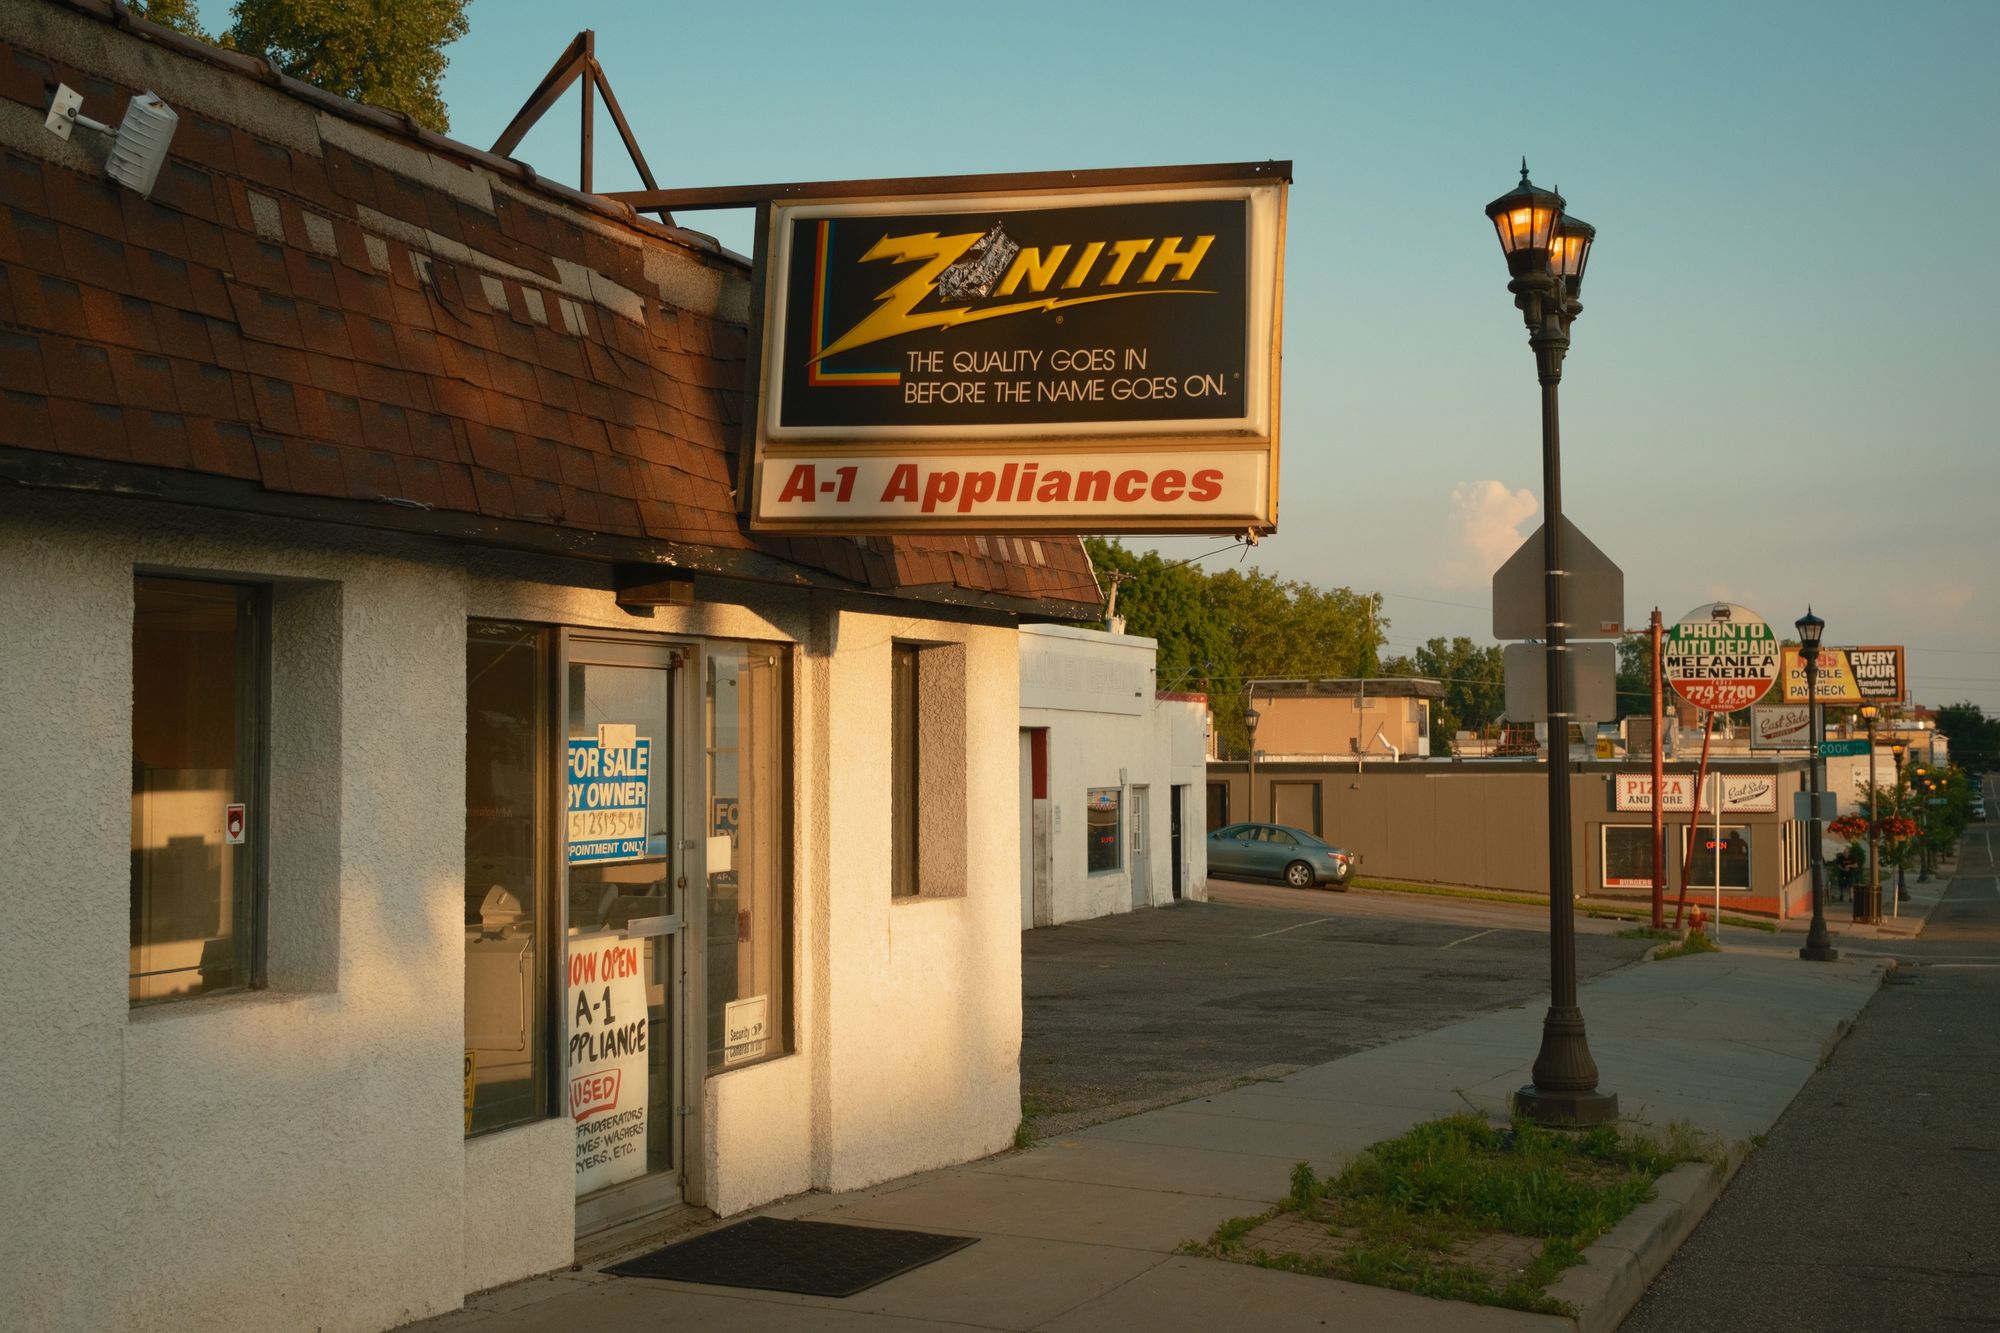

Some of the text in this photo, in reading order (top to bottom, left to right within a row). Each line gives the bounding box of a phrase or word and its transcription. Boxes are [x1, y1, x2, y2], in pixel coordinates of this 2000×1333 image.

[805, 231, 1218, 367] ZNITH
[907, 348, 1147, 373] THE QUALITY GOES IN
[904, 374, 1226, 404] BEFORE THE NAME GOES ON.
[778, 462, 1224, 513] A-1 Appliances
[1680, 623, 1764, 639] PRONTO
[1667, 639, 1776, 655] AUTO REPAIR
[1667, 656, 1775, 667] MECANICA
[1850, 651, 1895, 665] EVERY
[1682, 667, 1771, 678] GENERAL
[1791, 669, 1843, 679] DOBLE
[1856, 664, 1895, 678] HOUR
[1857, 679, 1896, 688] Tuesdays &
[1861, 687, 1896, 697] Thursdays
[1686, 685, 1756, 700] 774-7700
[1760, 709, 1809, 734] East Side
[1820, 744, 1849, 754] COOK
[603, 747, 648, 778] SALE
[587, 782, 646, 808] OWNER
[1628, 795, 1683, 804] AND ORE
[568, 840, 645, 857] POINTMENT ONLY
[601, 946, 638, 982] OPEN
[576, 985, 616, 1029] A-1
[730, 1025, 750, 1042] Security
[574, 1075, 615, 1108] USED
[613, 1142, 637, 1160] ETC.
